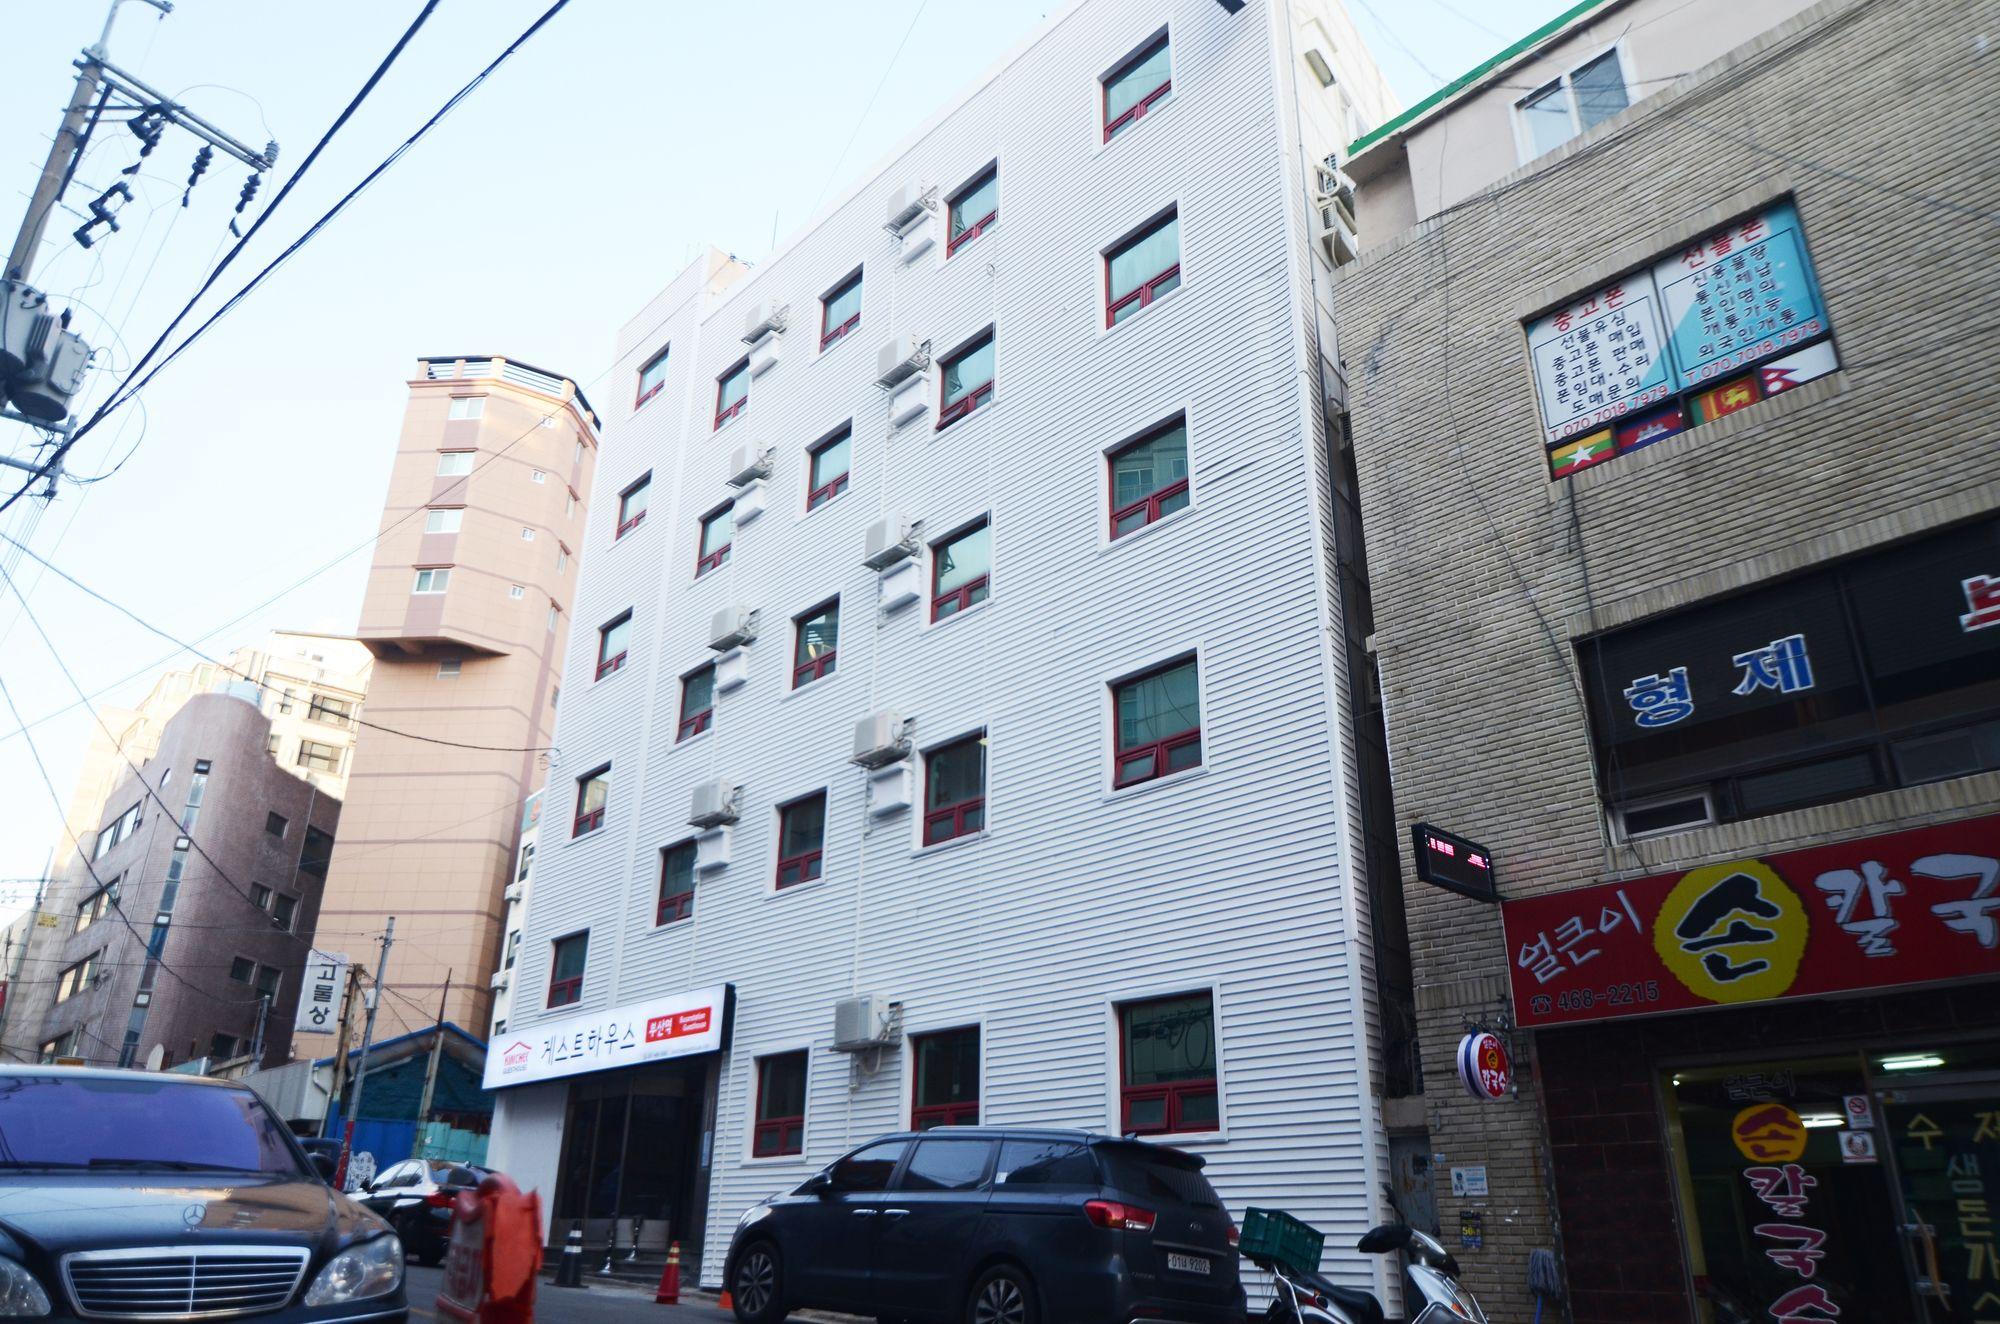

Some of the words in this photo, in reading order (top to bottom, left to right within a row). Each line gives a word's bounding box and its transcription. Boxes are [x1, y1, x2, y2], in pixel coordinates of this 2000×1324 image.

[1681, 216, 1765, 269] 선불폰
[1691, 244, 1768, 289] 신용불량
[1552, 284, 1626, 332] 중고폰
[1699, 278, 1777, 322] 본인명의
[1703, 297, 1782, 336] 개통가능
[1552, 340, 1599, 371] 중고폰
[1608, 320, 1642, 343] 매입
[1560, 310, 1627, 350] 선불유심
[1553, 356, 1602, 388] 중고폰
[1612, 336, 1647, 362] 판매
[1571, 374, 1641, 413] 도매문의
[1518, 889, 1643, 985] 얼큰이
[1673, 872, 1782, 982] 손
[308, 962, 337, 1025] 고물상
[1557, 981, 1660, 1013] 468-2215
[541, 1021, 635, 1066] 게스트하우스
[648, 1018, 673, 1038] 부산역
[1736, 1106, 1800, 1158] 손
